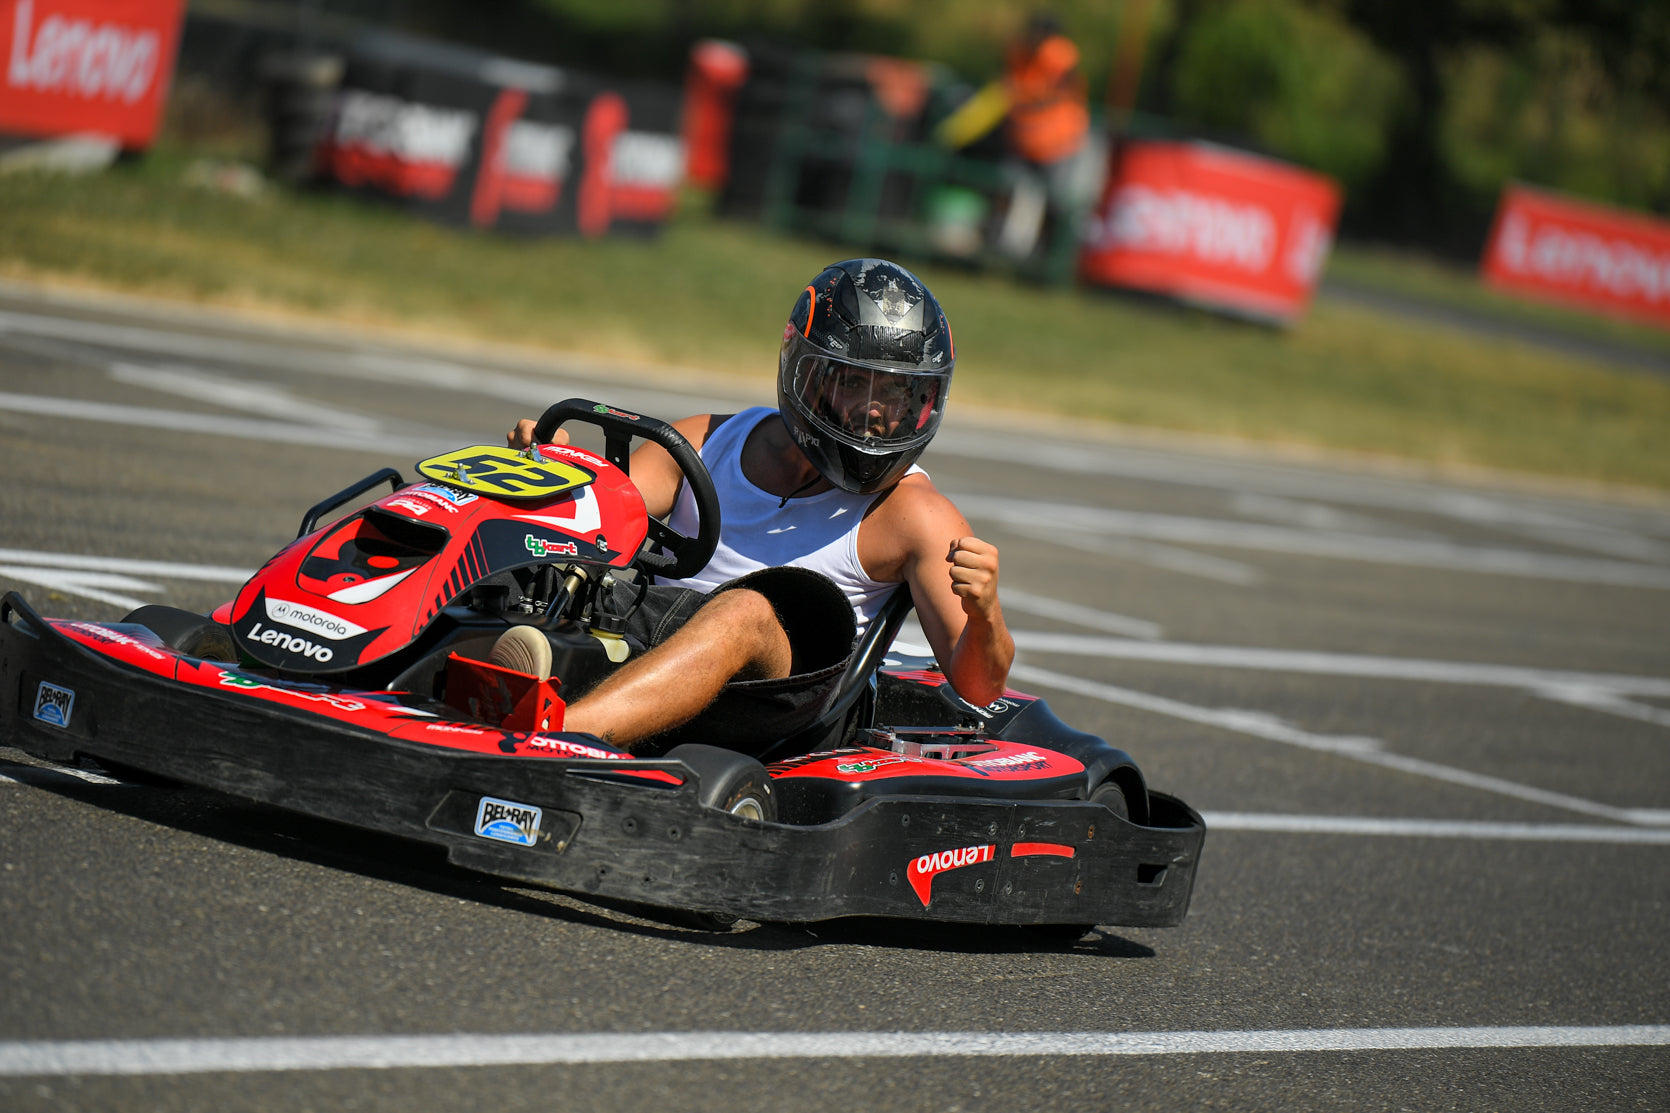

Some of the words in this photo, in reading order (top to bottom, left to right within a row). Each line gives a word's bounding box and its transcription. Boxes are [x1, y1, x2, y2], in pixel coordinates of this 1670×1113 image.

[8, 0, 162, 107] Lenovo
[425, 454, 570, 493] 52
[290, 609, 347, 635] motorola
[247, 622, 334, 663] Lenovo
[917, 845, 989, 874] Lenovo
